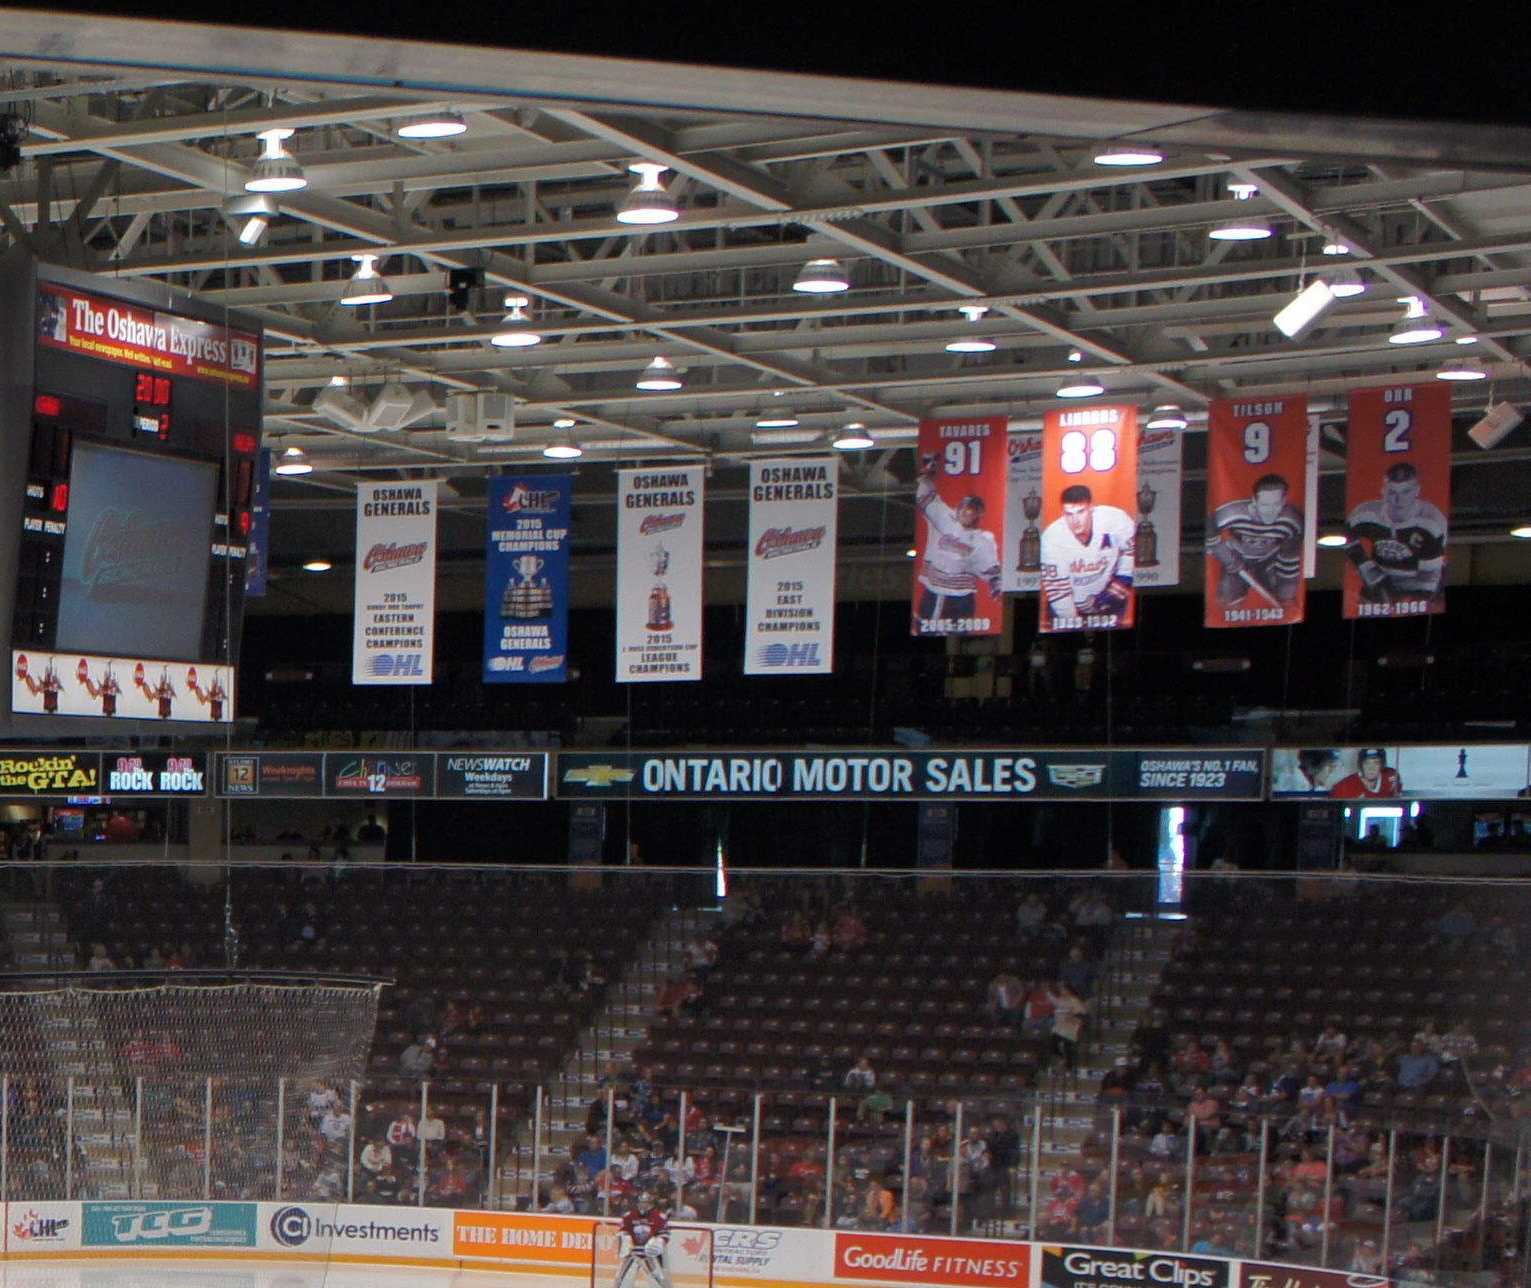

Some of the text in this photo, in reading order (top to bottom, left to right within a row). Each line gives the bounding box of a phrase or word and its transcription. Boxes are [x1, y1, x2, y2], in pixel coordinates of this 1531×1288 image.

[72, 298, 228, 366] The Oshawa Express
[1384, 388, 1413, 403] ORR
[1059, 409, 1119, 428] LINDROS
[1233, 401, 1284, 418] TILSON
[939, 424, 991, 438] TAVARES
[1384, 408, 1412, 453] 2
[1060, 428, 1117, 474] 88
[1243, 421, 1271, 465] 9
[944, 440, 982, 476] 91
[633, 473, 689, 490] OSHAWA
[372, 488, 423, 500] OSHAWA
[625, 491, 696, 510] GENERALS
[753, 483, 834, 503] GENERALS
[364, 501, 431, 517] GENERALS
[498, 541, 560, 553] CHAMPIONS
[373, 614, 415, 624] EASTERN
[765, 608, 814, 619] DIVISION
[365, 626, 425, 637] CONFERENCE
[641, 653, 678, 663] LEAGUE
[233, 767, 249, 781] 12
[446, 758, 531, 772] NEWSWATCH
[1140, 760, 1201, 773] OSHAWA'S
[0, 769, 97, 794] the GTA!
[109, 772, 153, 791] ROCK
[159, 772, 203, 791] ROCK
[464, 772, 513, 784] Weekdays
[642, 758, 1037, 794] ONTARIO MOTOR SALES
[1140, 772, 1227, 788] SINCE 1923
[315, 1217, 439, 1243] Investments
[456, 1225, 497, 1245] THE
[500, 1227, 557, 1249] HOME
[843, 1245, 1020, 1278] GoodLife FITNESS
[1063, 1252, 1143, 1280] Great
